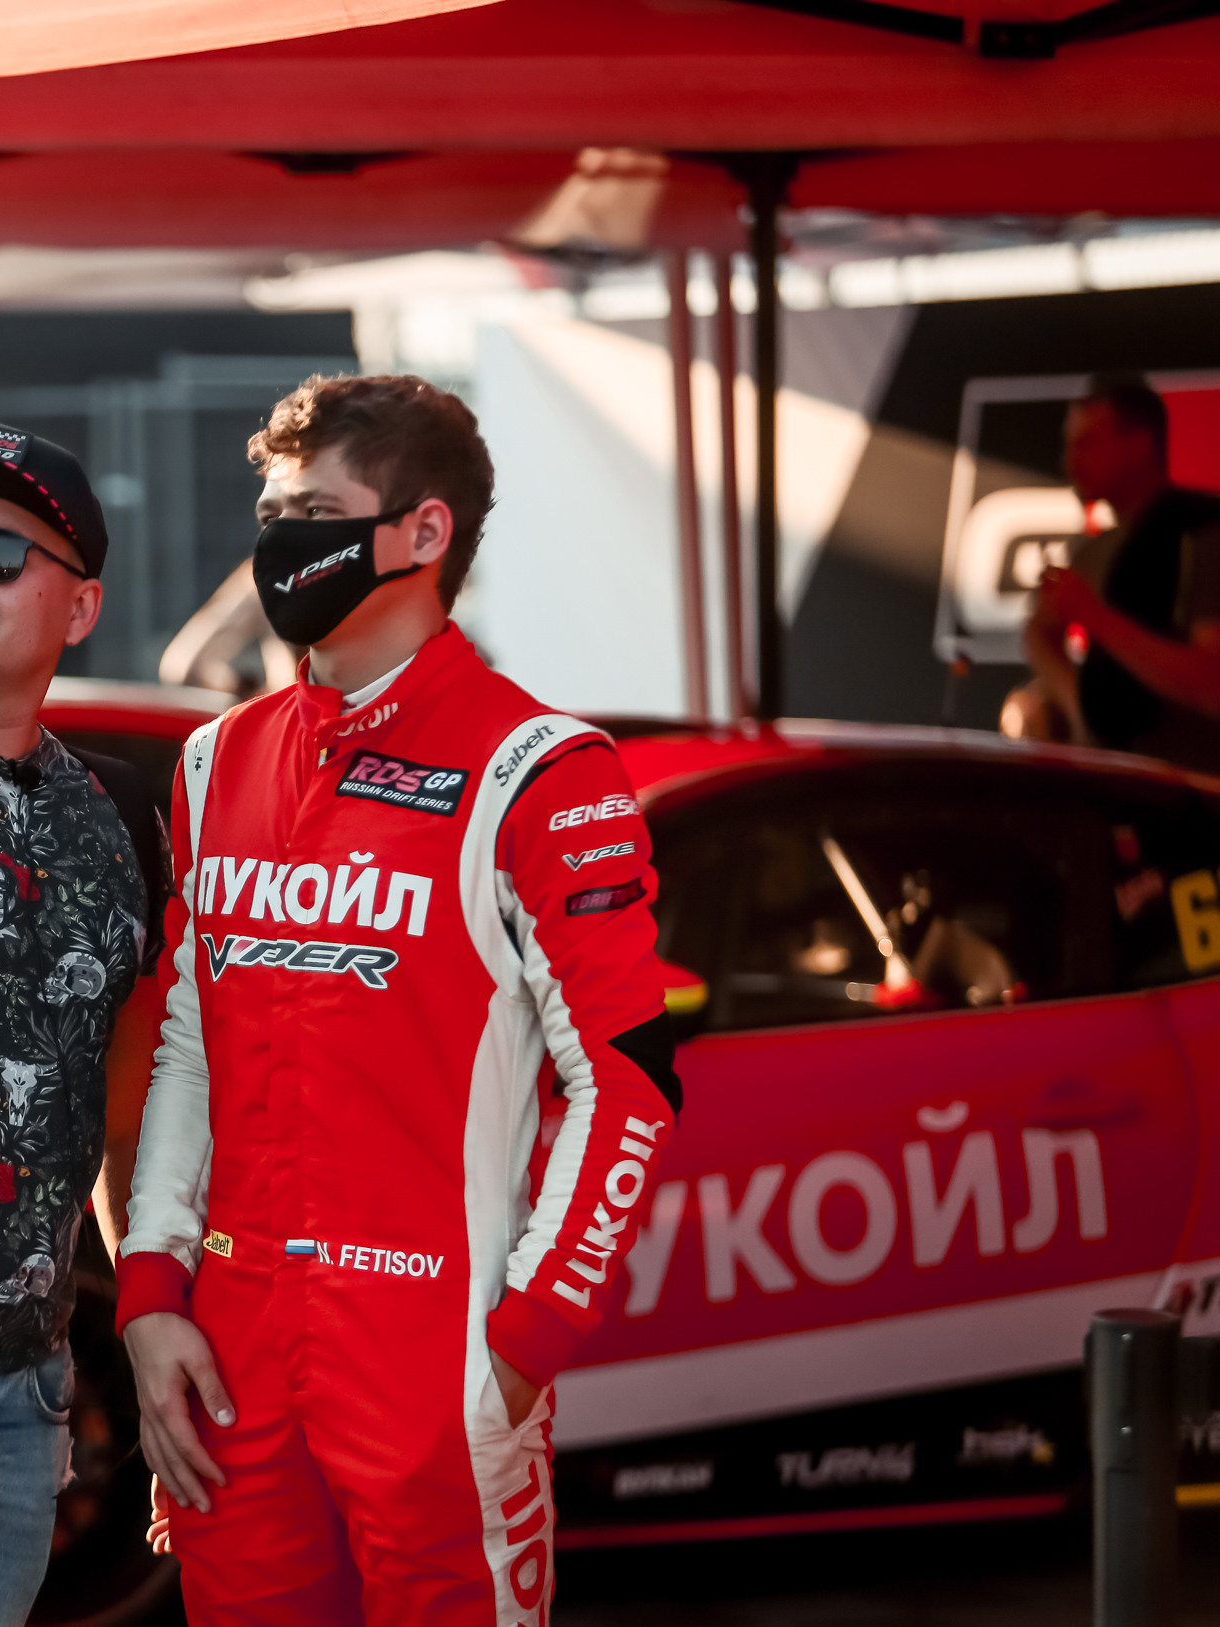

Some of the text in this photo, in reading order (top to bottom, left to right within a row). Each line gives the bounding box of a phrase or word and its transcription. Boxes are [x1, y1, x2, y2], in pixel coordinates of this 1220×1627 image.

[274, 543, 362, 594] VIPER
[348, 756, 463, 793] RDS GP
[495, 725, 555, 787] Sabelt
[340, 781, 454, 811] RUSSIAN DRIFT SERIES
[561, 841, 636, 872] VIPE
[200, 933, 400, 990] VIPER
[551, 1114, 666, 1309] LUKOIL
[622, 1100, 1109, 1318] УКОЙЛ
[339, 1244, 445, 1279] FETISOV
